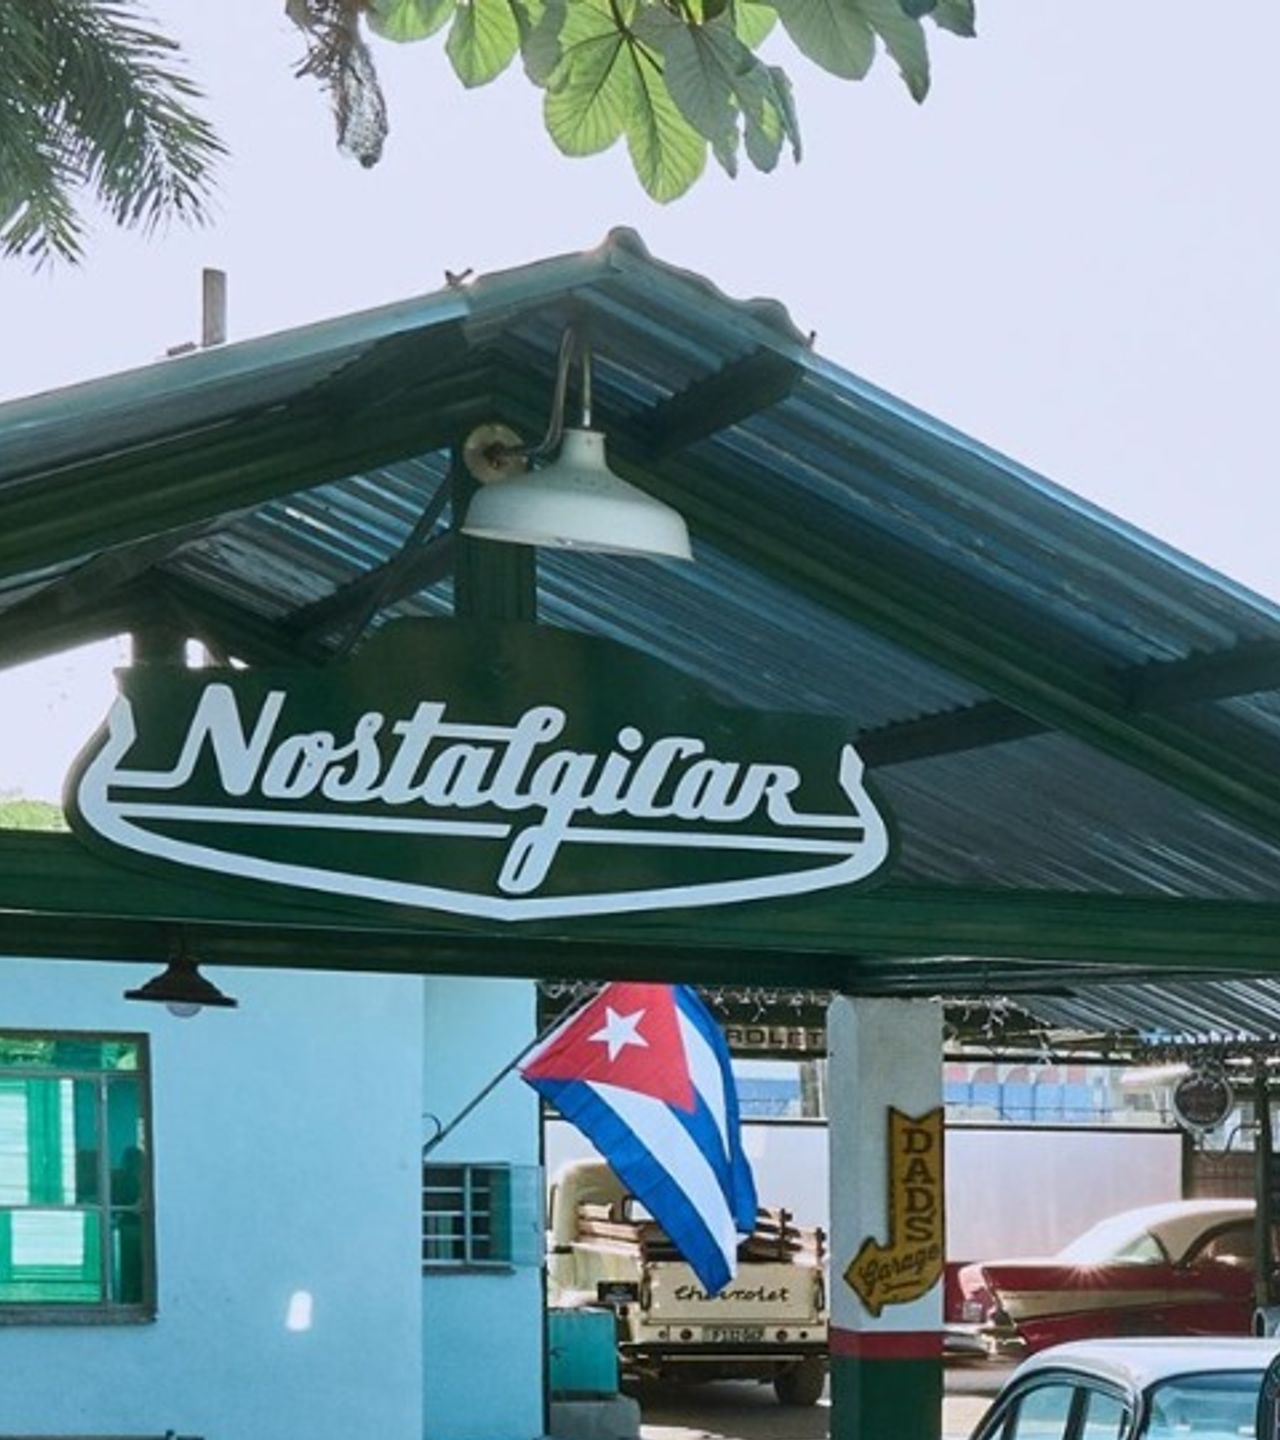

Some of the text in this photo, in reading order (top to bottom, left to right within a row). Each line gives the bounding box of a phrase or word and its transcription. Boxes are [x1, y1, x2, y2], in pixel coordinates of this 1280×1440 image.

[726, 1028, 823, 1044] ROLET
[857, 1243, 941, 1298] Garage
[674, 1285, 789, 1302] Chvrolet
